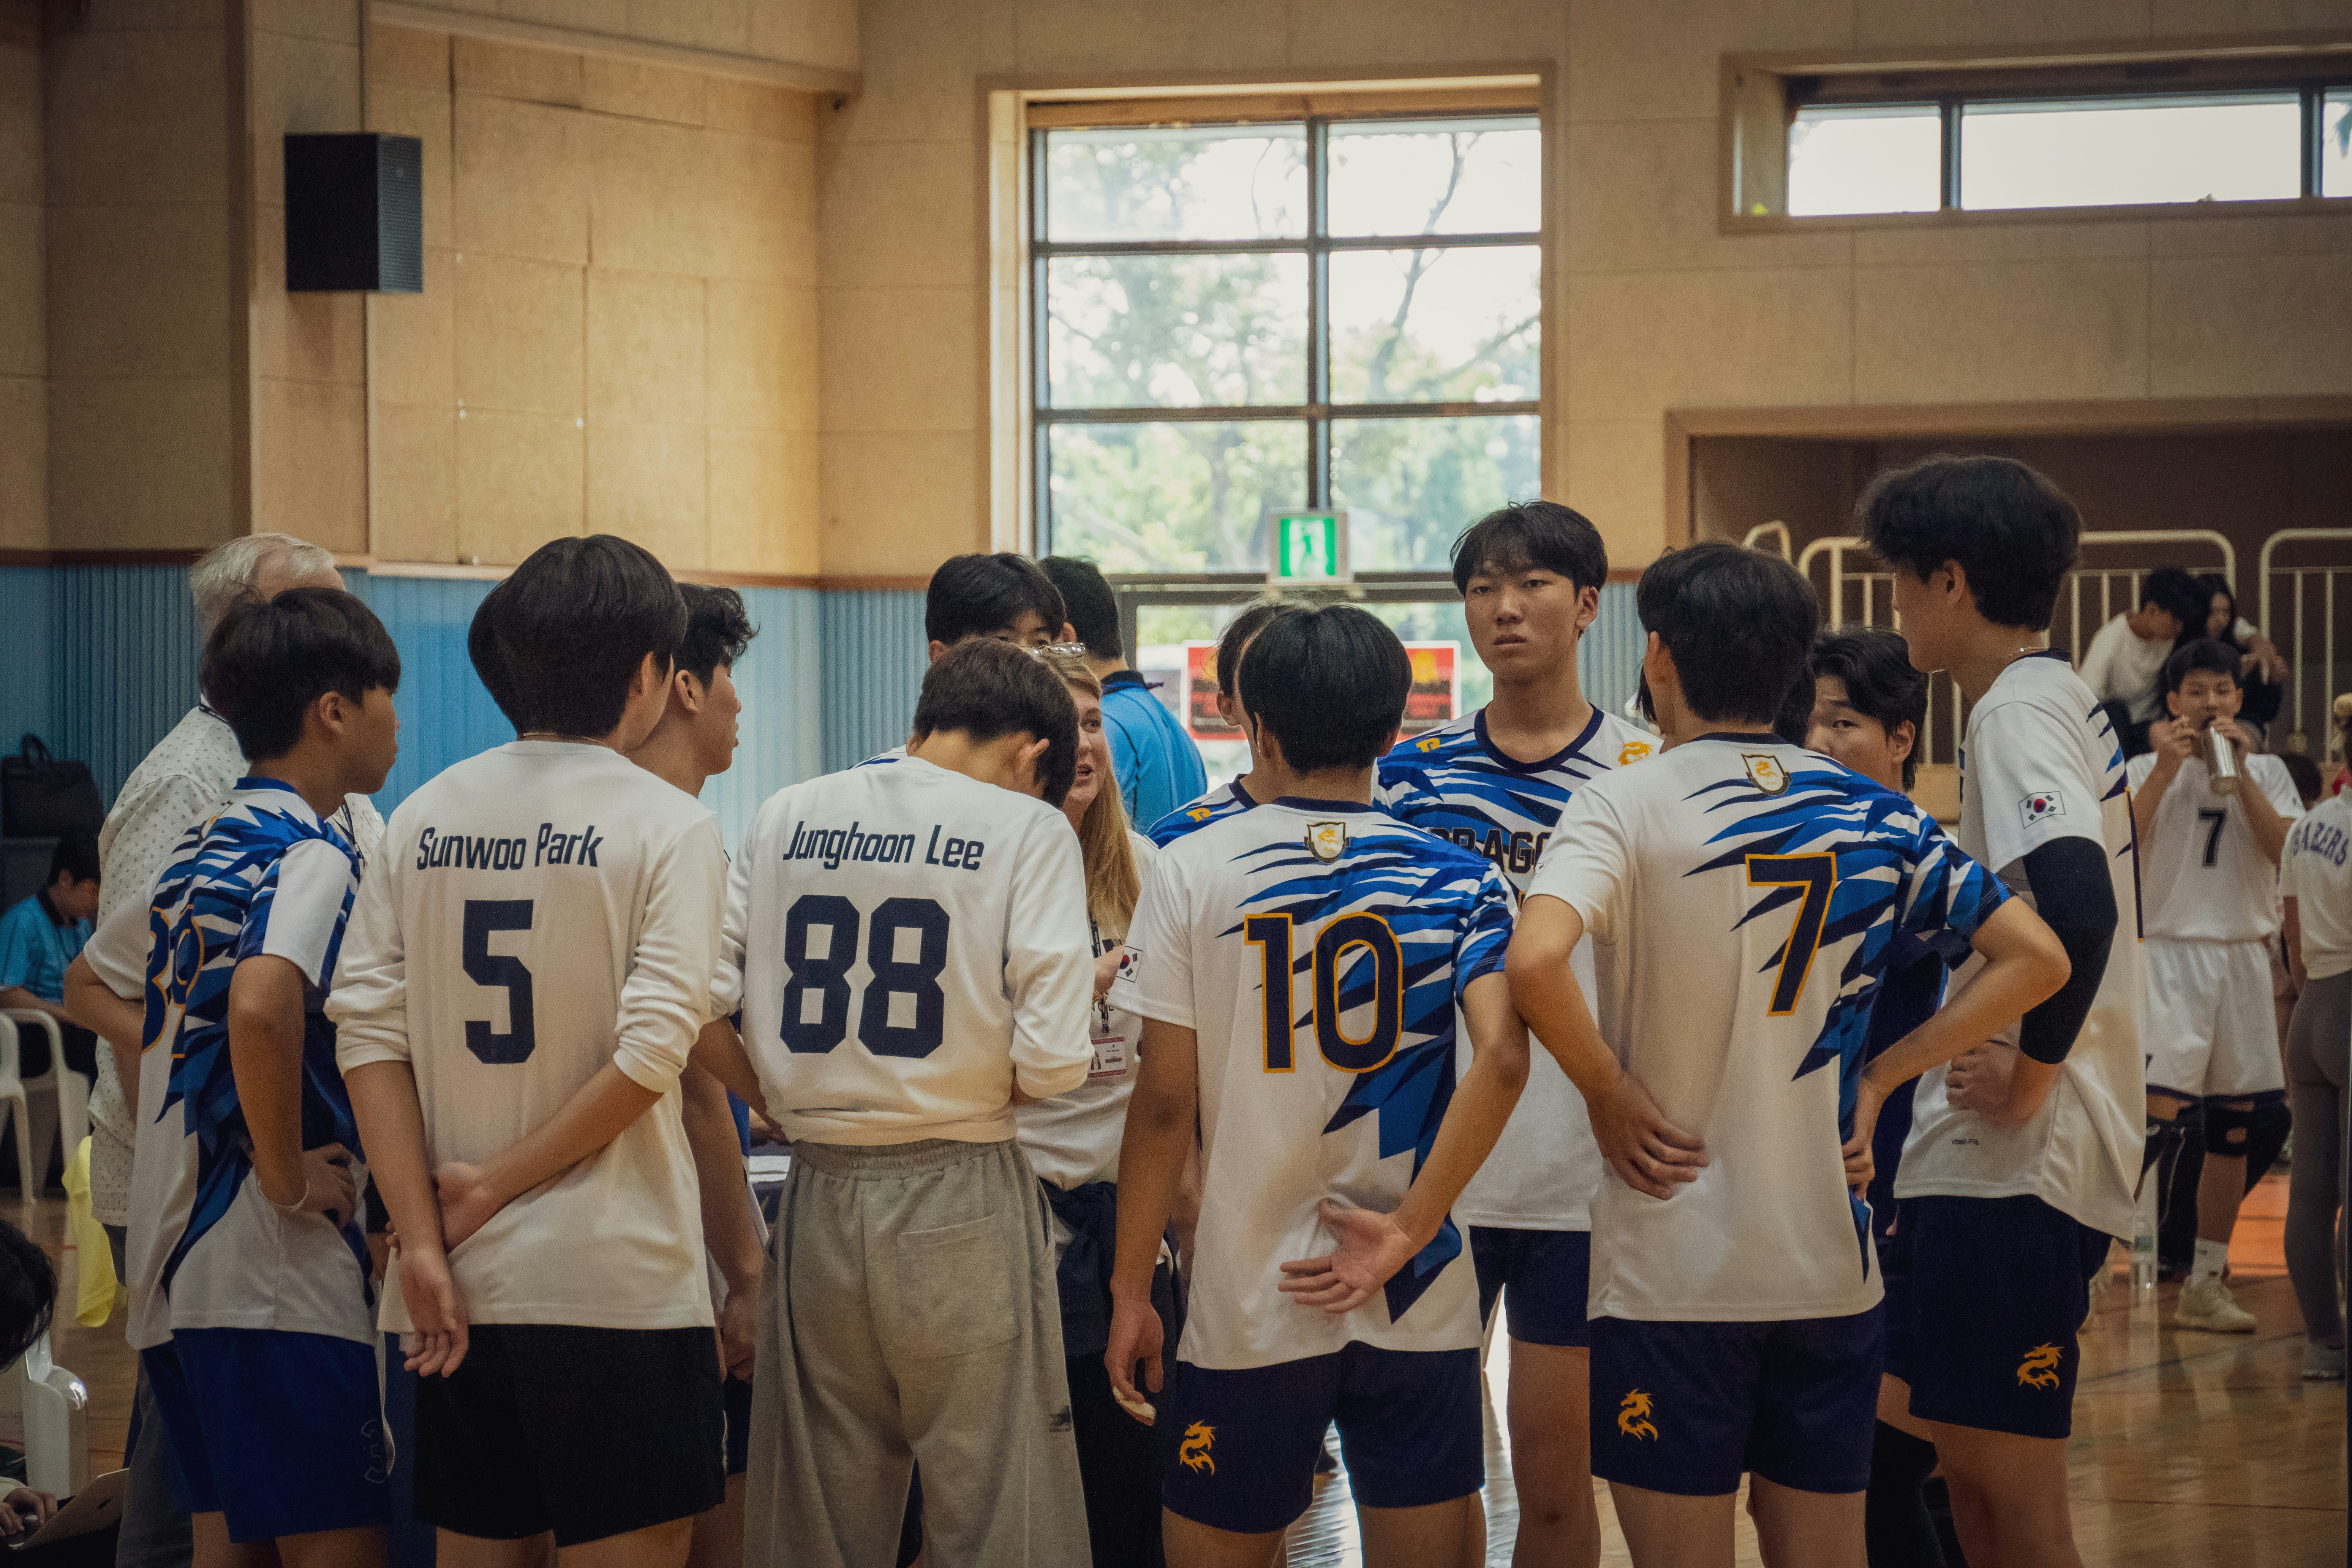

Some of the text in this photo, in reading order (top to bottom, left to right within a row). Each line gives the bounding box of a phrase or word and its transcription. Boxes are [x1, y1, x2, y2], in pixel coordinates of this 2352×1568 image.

[416, 822, 604, 871] Sunwoo Park
[782, 821, 985, 871] Junghoon Lee
[2197, 807, 2228, 868] 7
[462, 899, 536, 1065] 5
[779, 895, 950, 1059] 88
[1243, 911, 1404, 1074] 10
[1745, 851, 1837, 1017] 7
